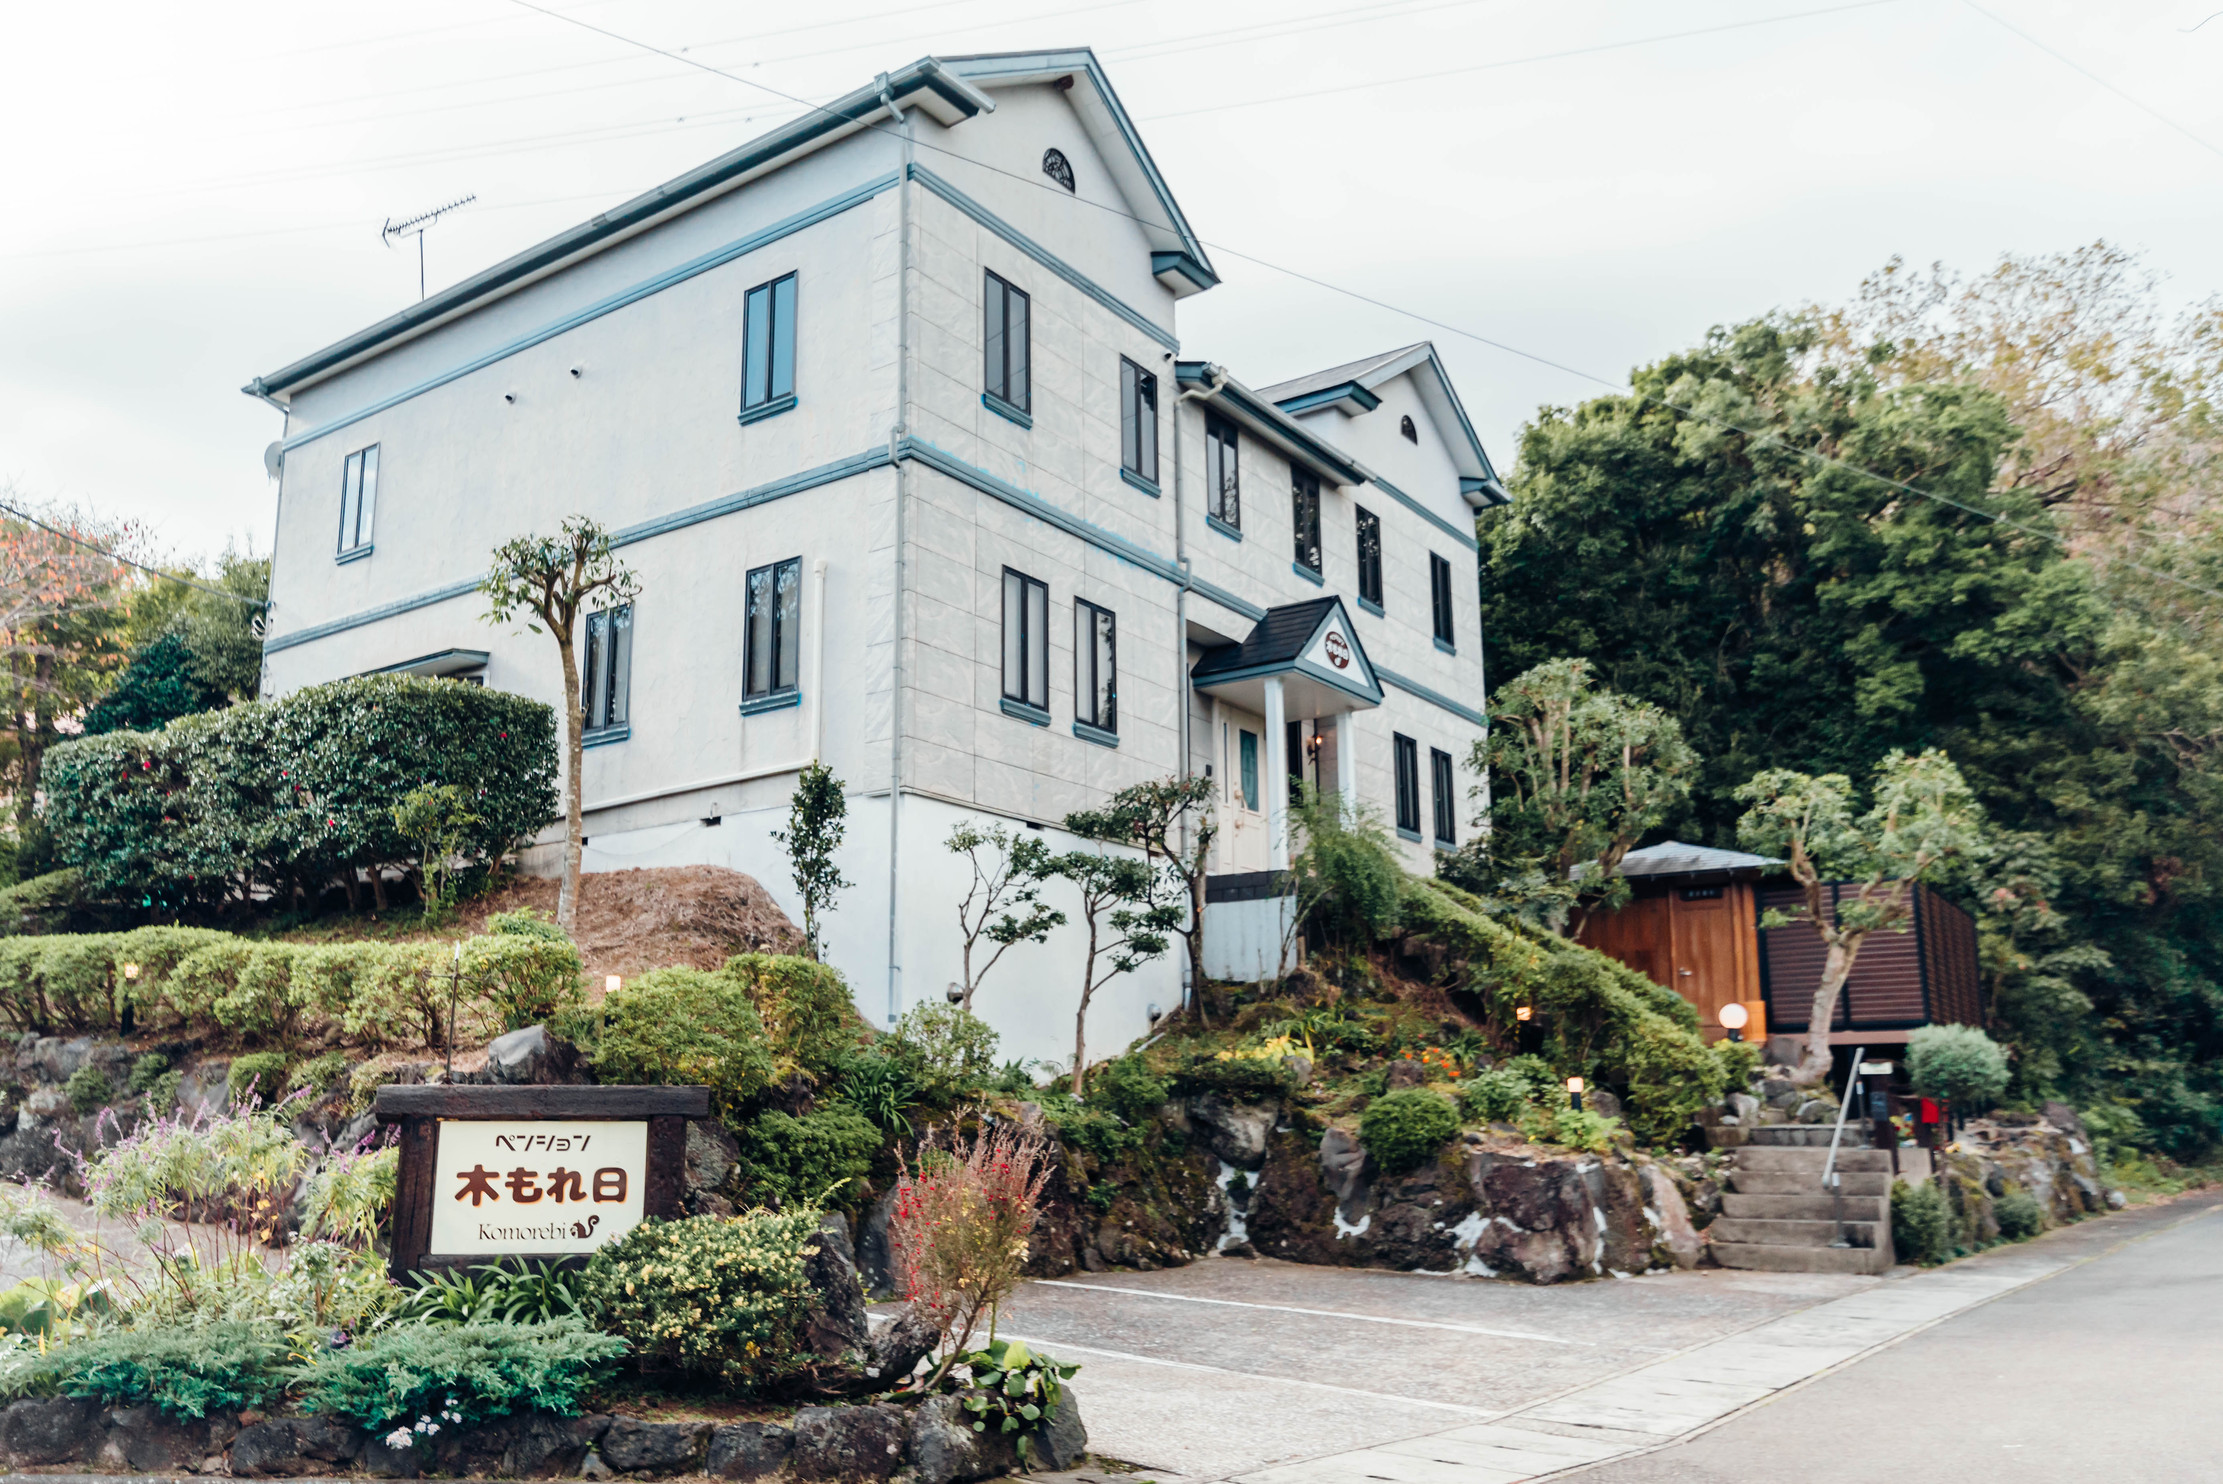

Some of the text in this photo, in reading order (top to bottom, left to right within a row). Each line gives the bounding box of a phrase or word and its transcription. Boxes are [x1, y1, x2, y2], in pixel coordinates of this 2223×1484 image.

[496, 1135, 591, 1151] ペンション
[454, 1164, 627, 1207] 木もれ日
[478, 1223, 566, 1241] Komorebi
